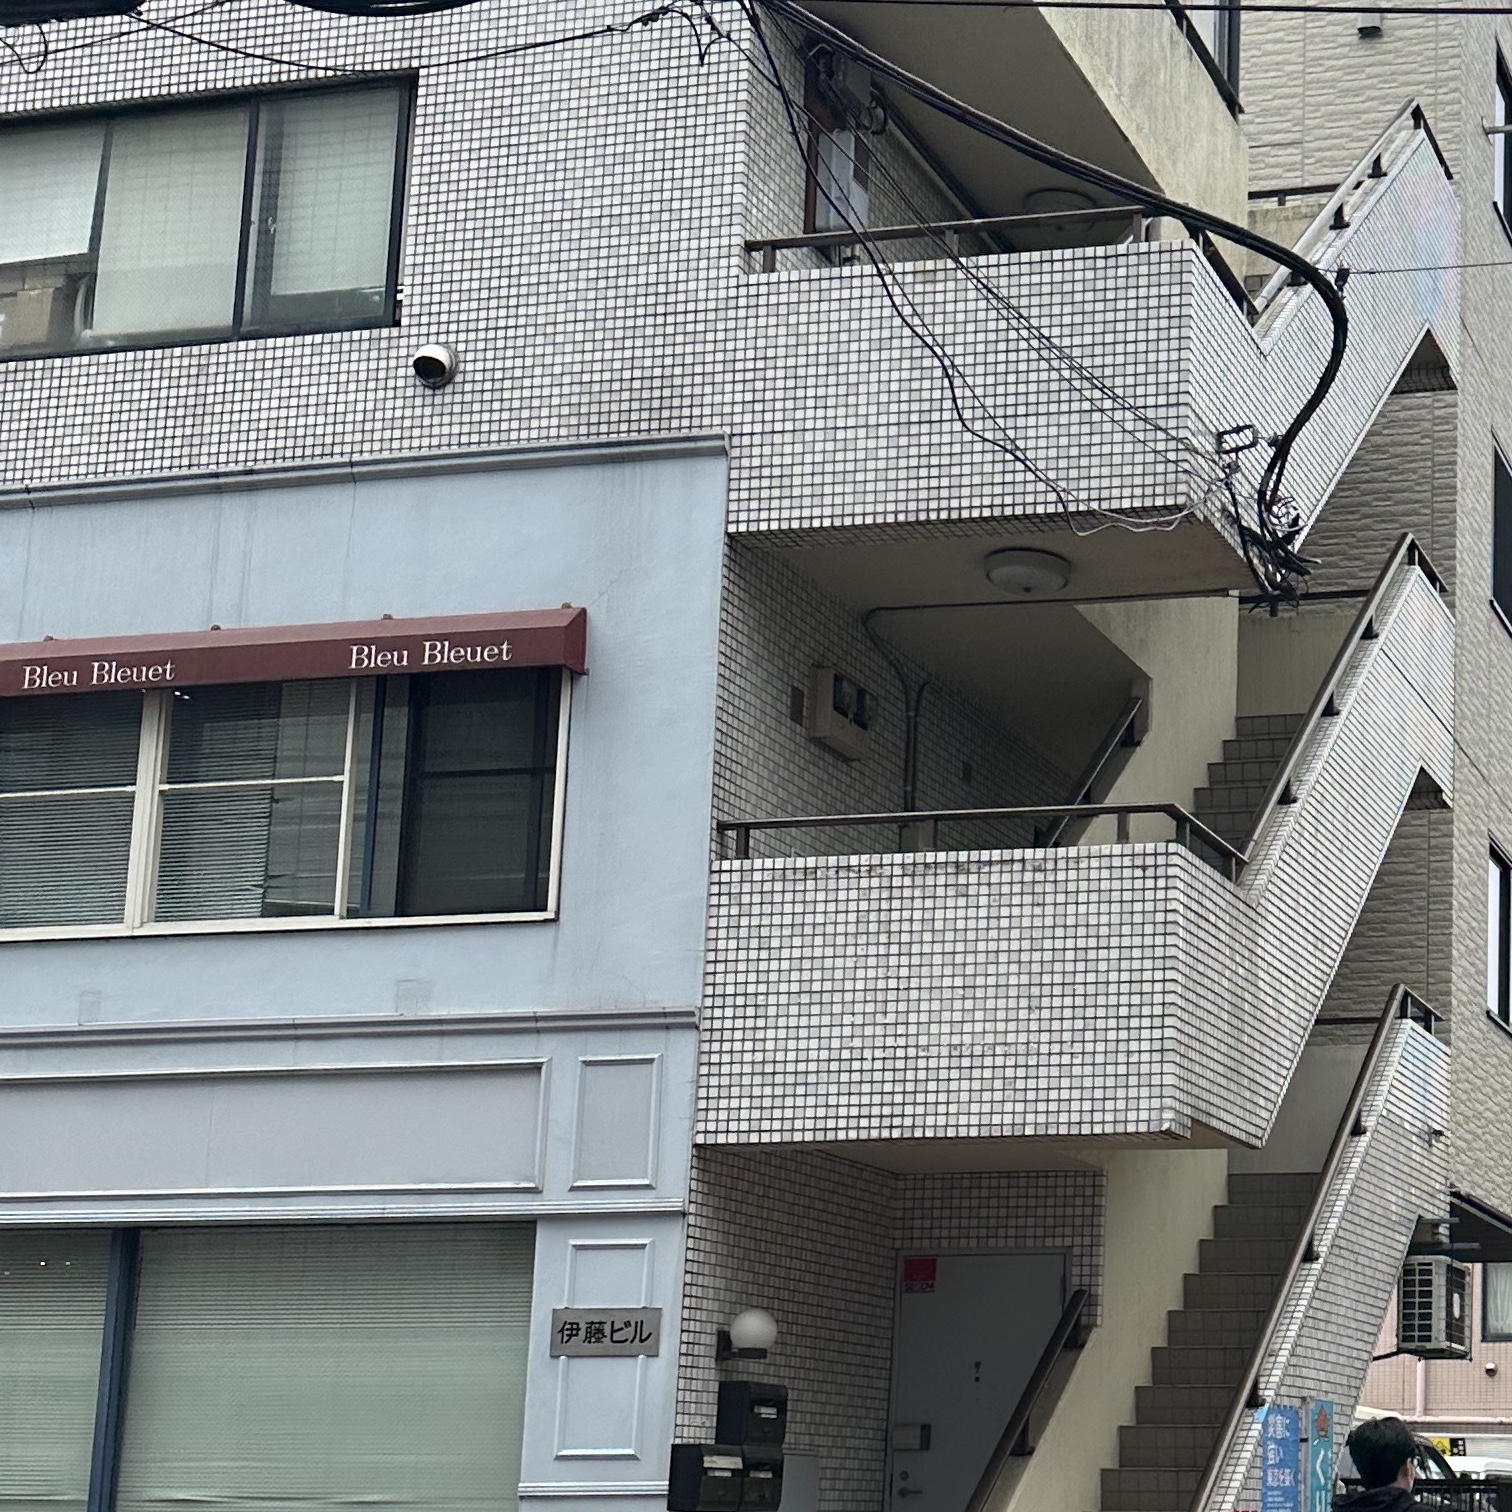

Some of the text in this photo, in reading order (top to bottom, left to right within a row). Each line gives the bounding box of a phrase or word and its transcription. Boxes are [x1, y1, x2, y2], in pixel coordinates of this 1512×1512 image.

[348, 639, 512, 669] Bleu Bleuet
[22, 660, 175, 689] Bleu Bleuet
[557, 1318, 653, 1346] 伊藤ビル
